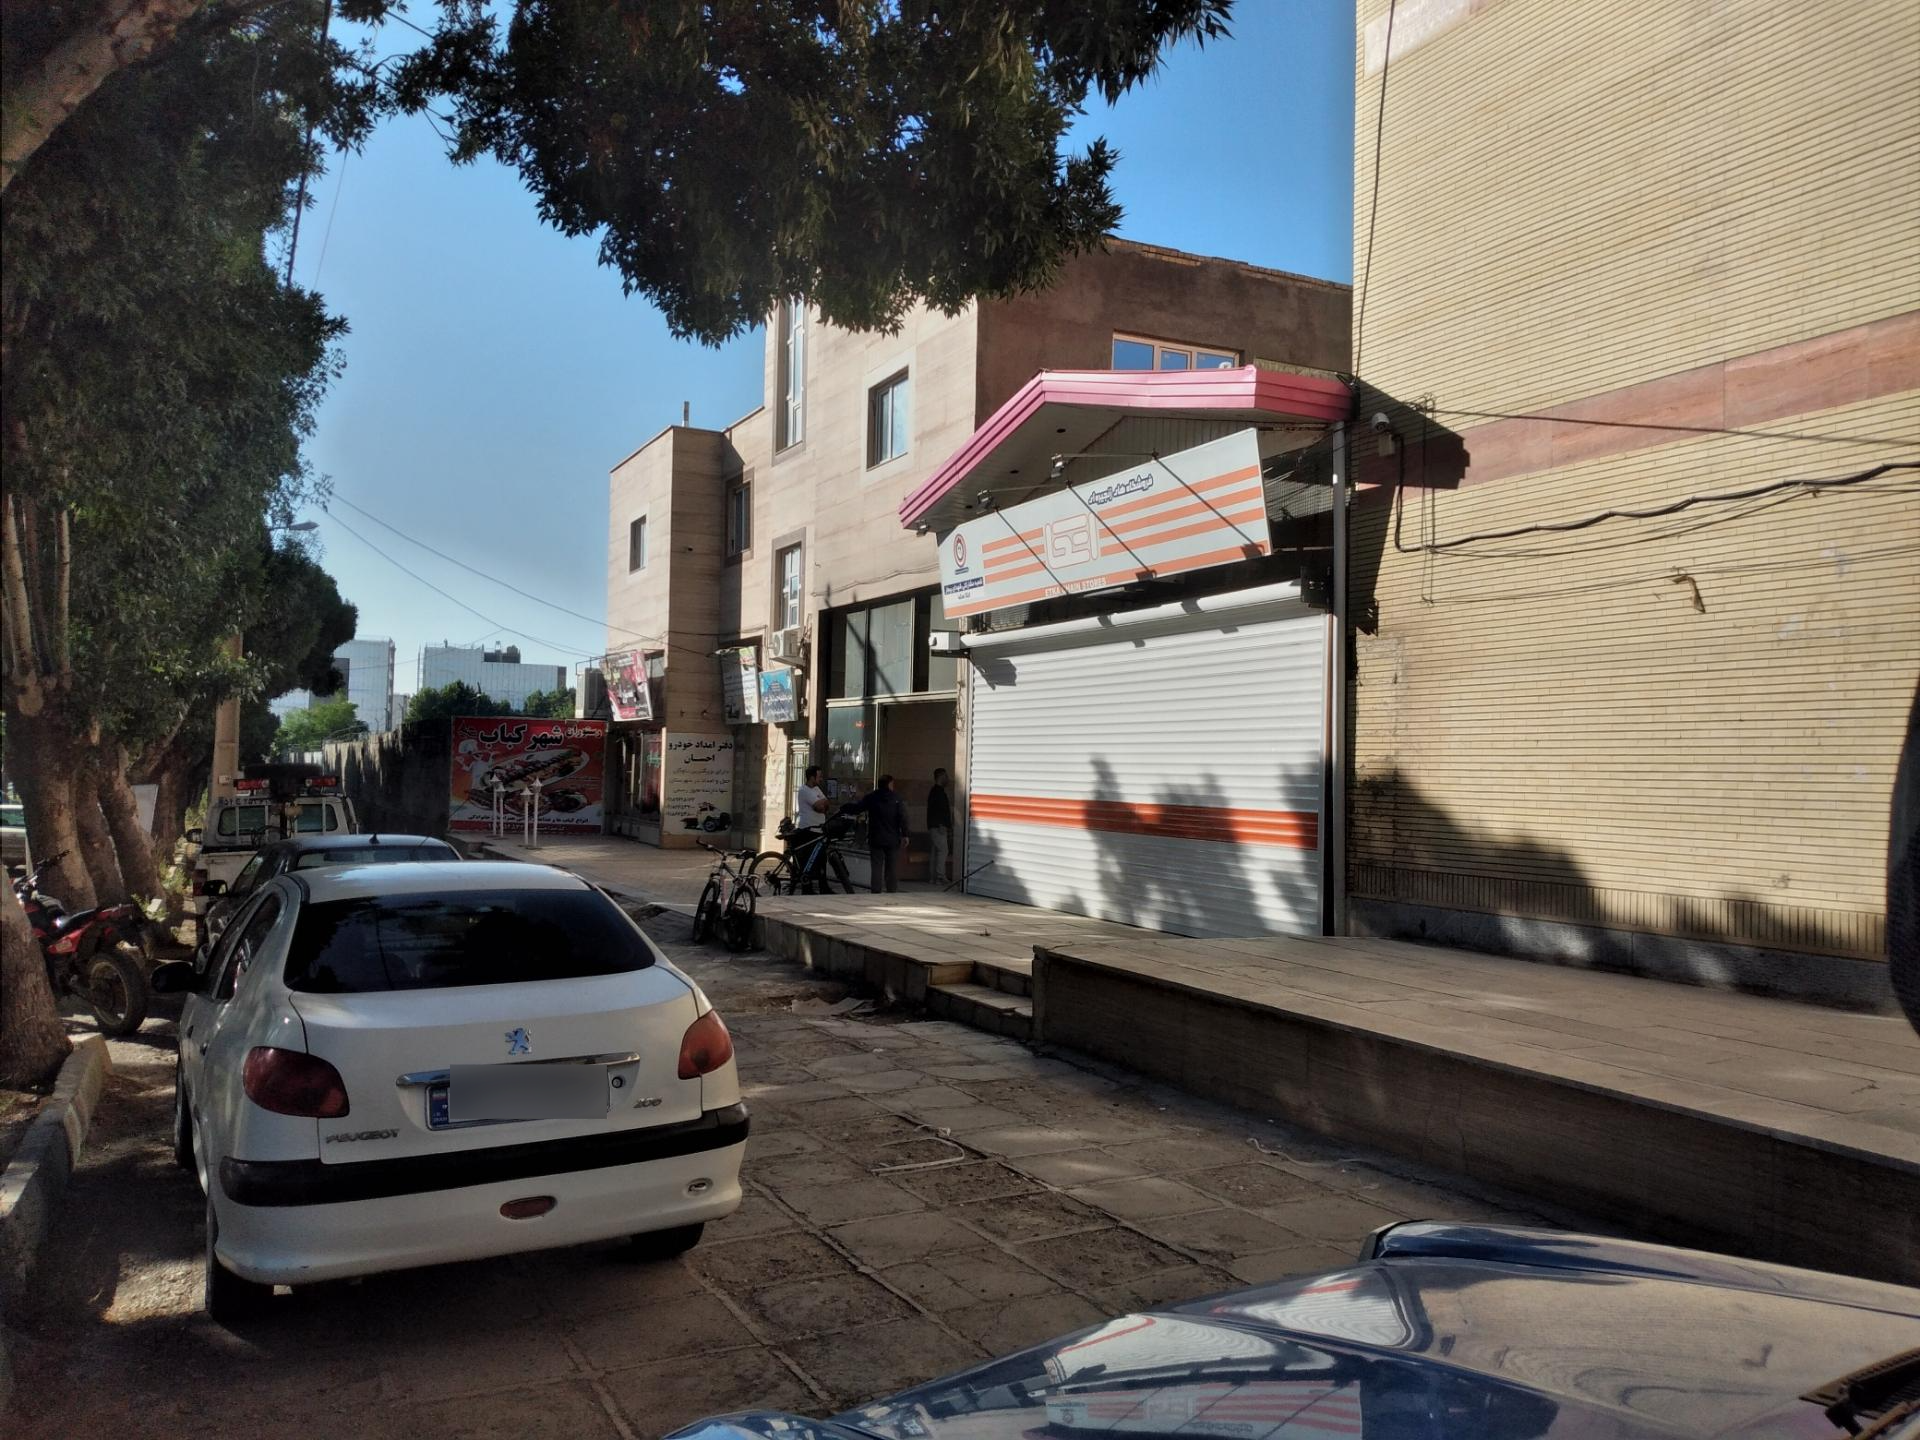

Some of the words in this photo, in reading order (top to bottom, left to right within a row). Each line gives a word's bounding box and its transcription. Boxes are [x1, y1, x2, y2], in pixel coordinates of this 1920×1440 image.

[479, 723, 528, 749] کباب
[566, 724, 602, 738] رستوران
[525, 726, 564, 751] شهر
[695, 741, 715, 749] امداد
[669, 741, 693, 751] خودرو
[718, 742, 733, 751] دفتر
[325, 1128, 400, 1144] PEUGEOT
